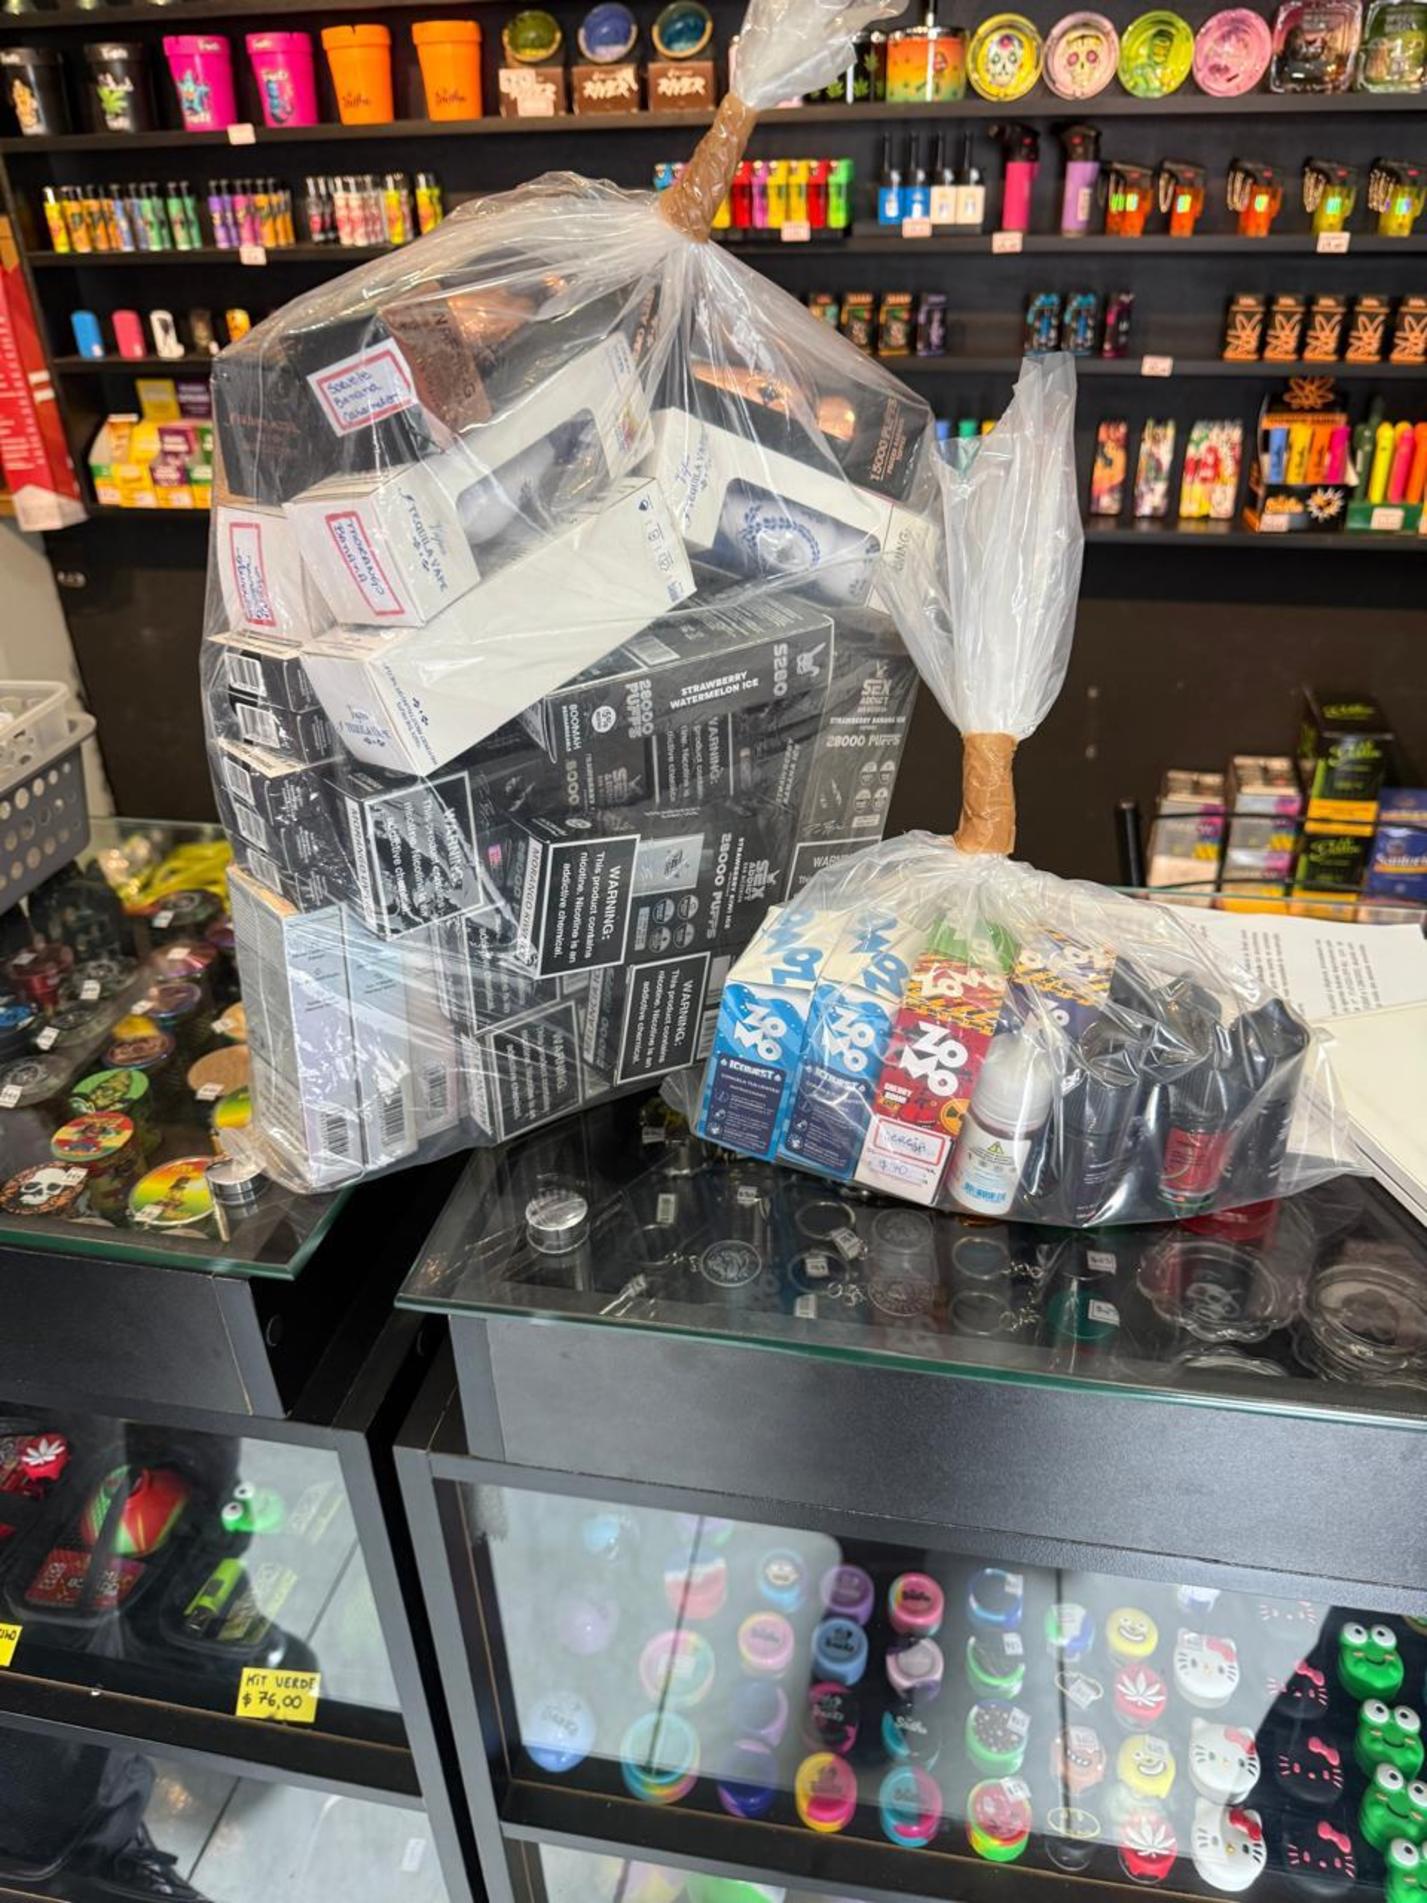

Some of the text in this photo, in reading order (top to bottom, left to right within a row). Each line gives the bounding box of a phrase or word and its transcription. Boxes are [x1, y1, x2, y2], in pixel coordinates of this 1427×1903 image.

[625, 682, 642, 738] PUFFS
[639, 679, 655, 735] 28000
[670, 678, 759, 710] WATERMELON ICE
[681, 671, 748, 696] STRAWBERRY
[826, 735, 866, 747] 28000
[526, 849, 540, 910] MORANGO
[595, 851, 605, 874] This
[707, 832, 731, 939] 28000 PUFFS
[731, 837, 744, 891] STRAWBERRY
[752, 860, 769, 899] SEX
[554, 862, 571, 958] addictive chemical.
[569, 851, 588, 963] nicotine. Nicotine is an
[590, 875, 600, 914] product
[601, 865, 621, 940] WARNING:
[585, 916, 595, 958] contains
[632, 980, 650, 1065] addictive chemical.
[644, 970, 665, 1068] nicotine. Nicotine is an
[659, 968, 679, 1063] This product contains
[674, 979, 693, 1046] WARNING:
[242, 1691, 302, 1710] $ 76,00
[275, 1676, 316, 1689] VERDE
